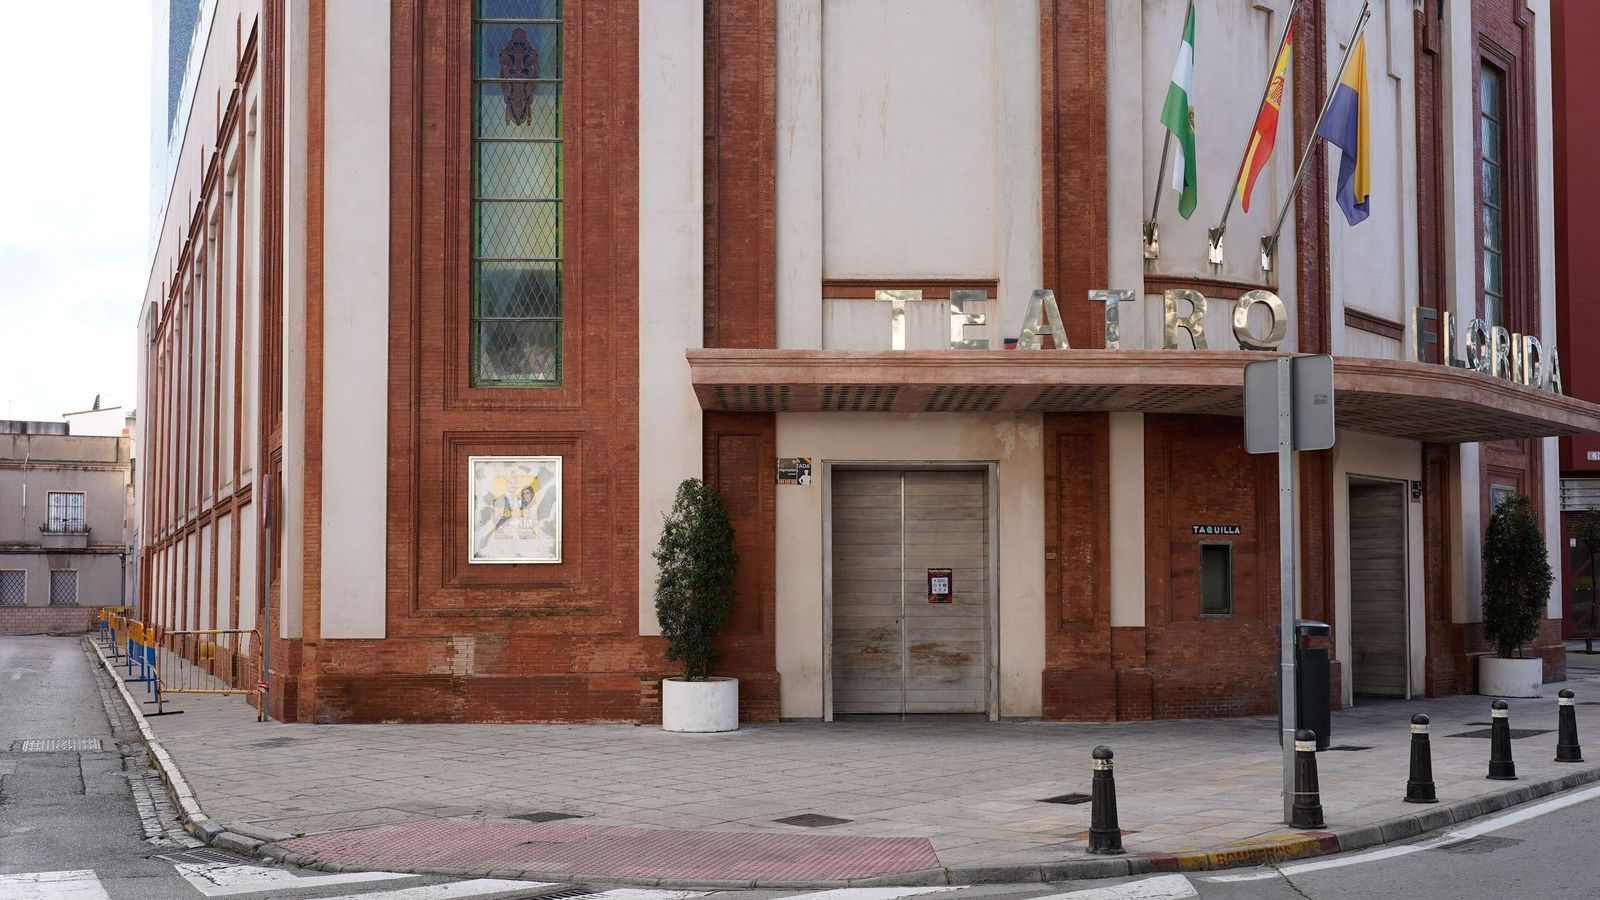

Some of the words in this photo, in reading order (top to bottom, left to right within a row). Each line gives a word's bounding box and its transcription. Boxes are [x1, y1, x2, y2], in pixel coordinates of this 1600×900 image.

[874, 288, 1288, 352] TEATRO
[1412, 306, 1564, 396] FLORIDA
[1193, 525, 1240, 534] TAQUILLA
